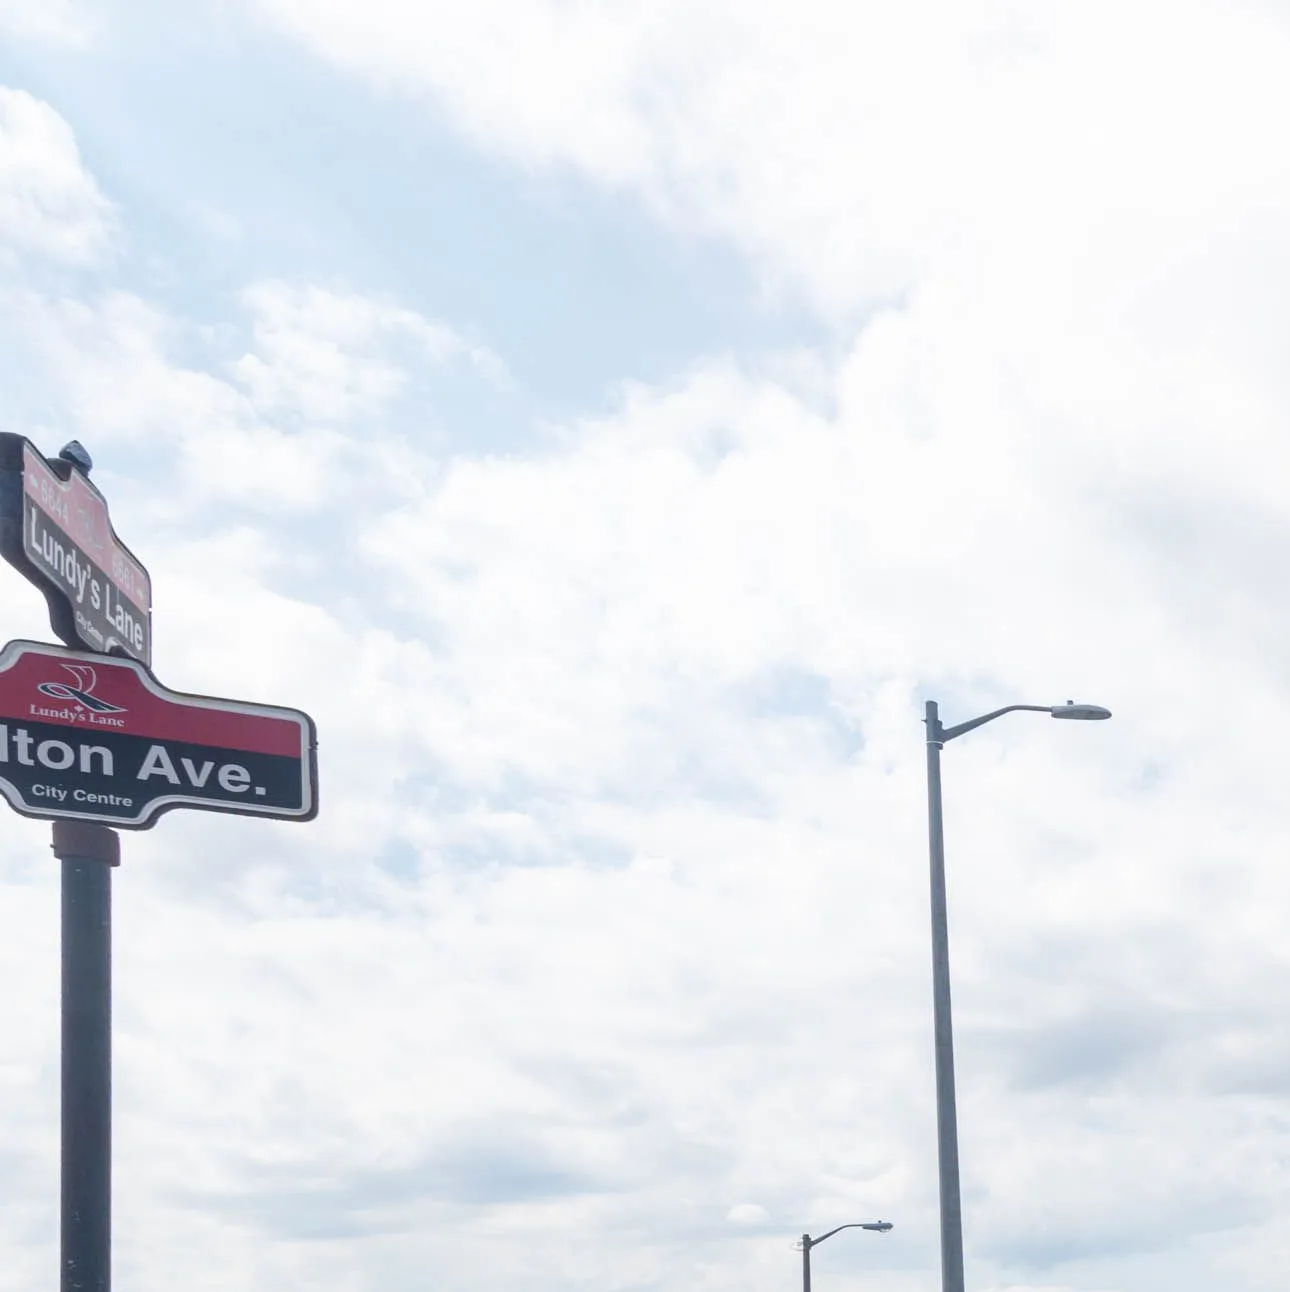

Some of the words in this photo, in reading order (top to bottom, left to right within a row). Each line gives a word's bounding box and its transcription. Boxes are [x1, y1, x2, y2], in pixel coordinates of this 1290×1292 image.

[31, 506, 101, 611] Lundy's
[106, 583, 144, 651] Lane
[29, 703, 86, 724] Lundy's
[89, 712, 126, 728] Lane
[137, 744, 267, 796] Ave.
[32, 783, 68, 802] City
[73, 789, 134, 808] Centre
